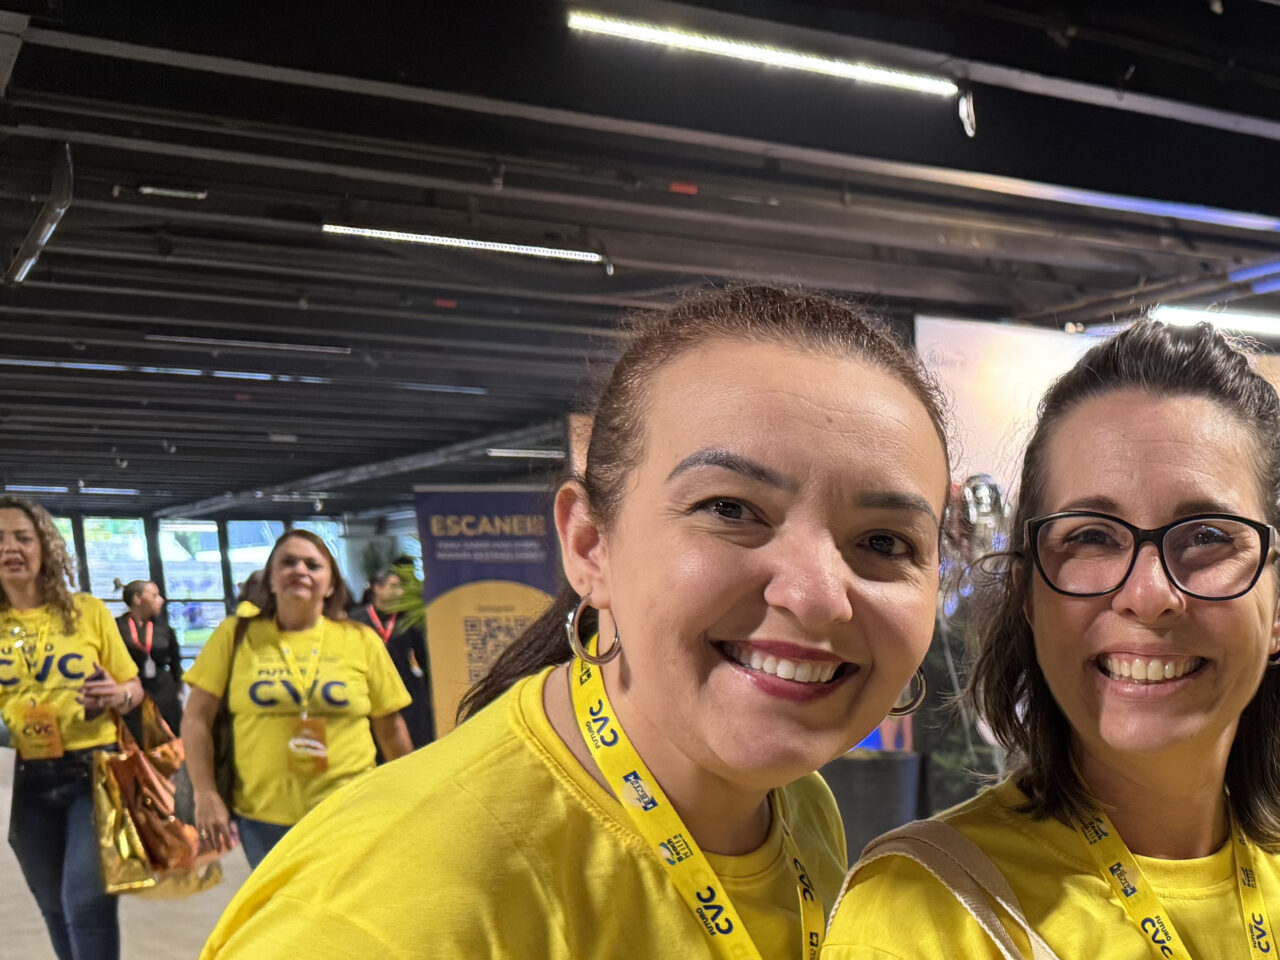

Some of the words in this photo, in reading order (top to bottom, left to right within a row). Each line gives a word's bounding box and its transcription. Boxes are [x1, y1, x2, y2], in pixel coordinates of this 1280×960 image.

[249, 680, 350, 707] CVC
[589, 698, 619, 748] CVC
[696, 886, 734, 936] CVC
[1252, 911, 1270, 954] CVC
[1142, 916, 1172, 959] CVC
